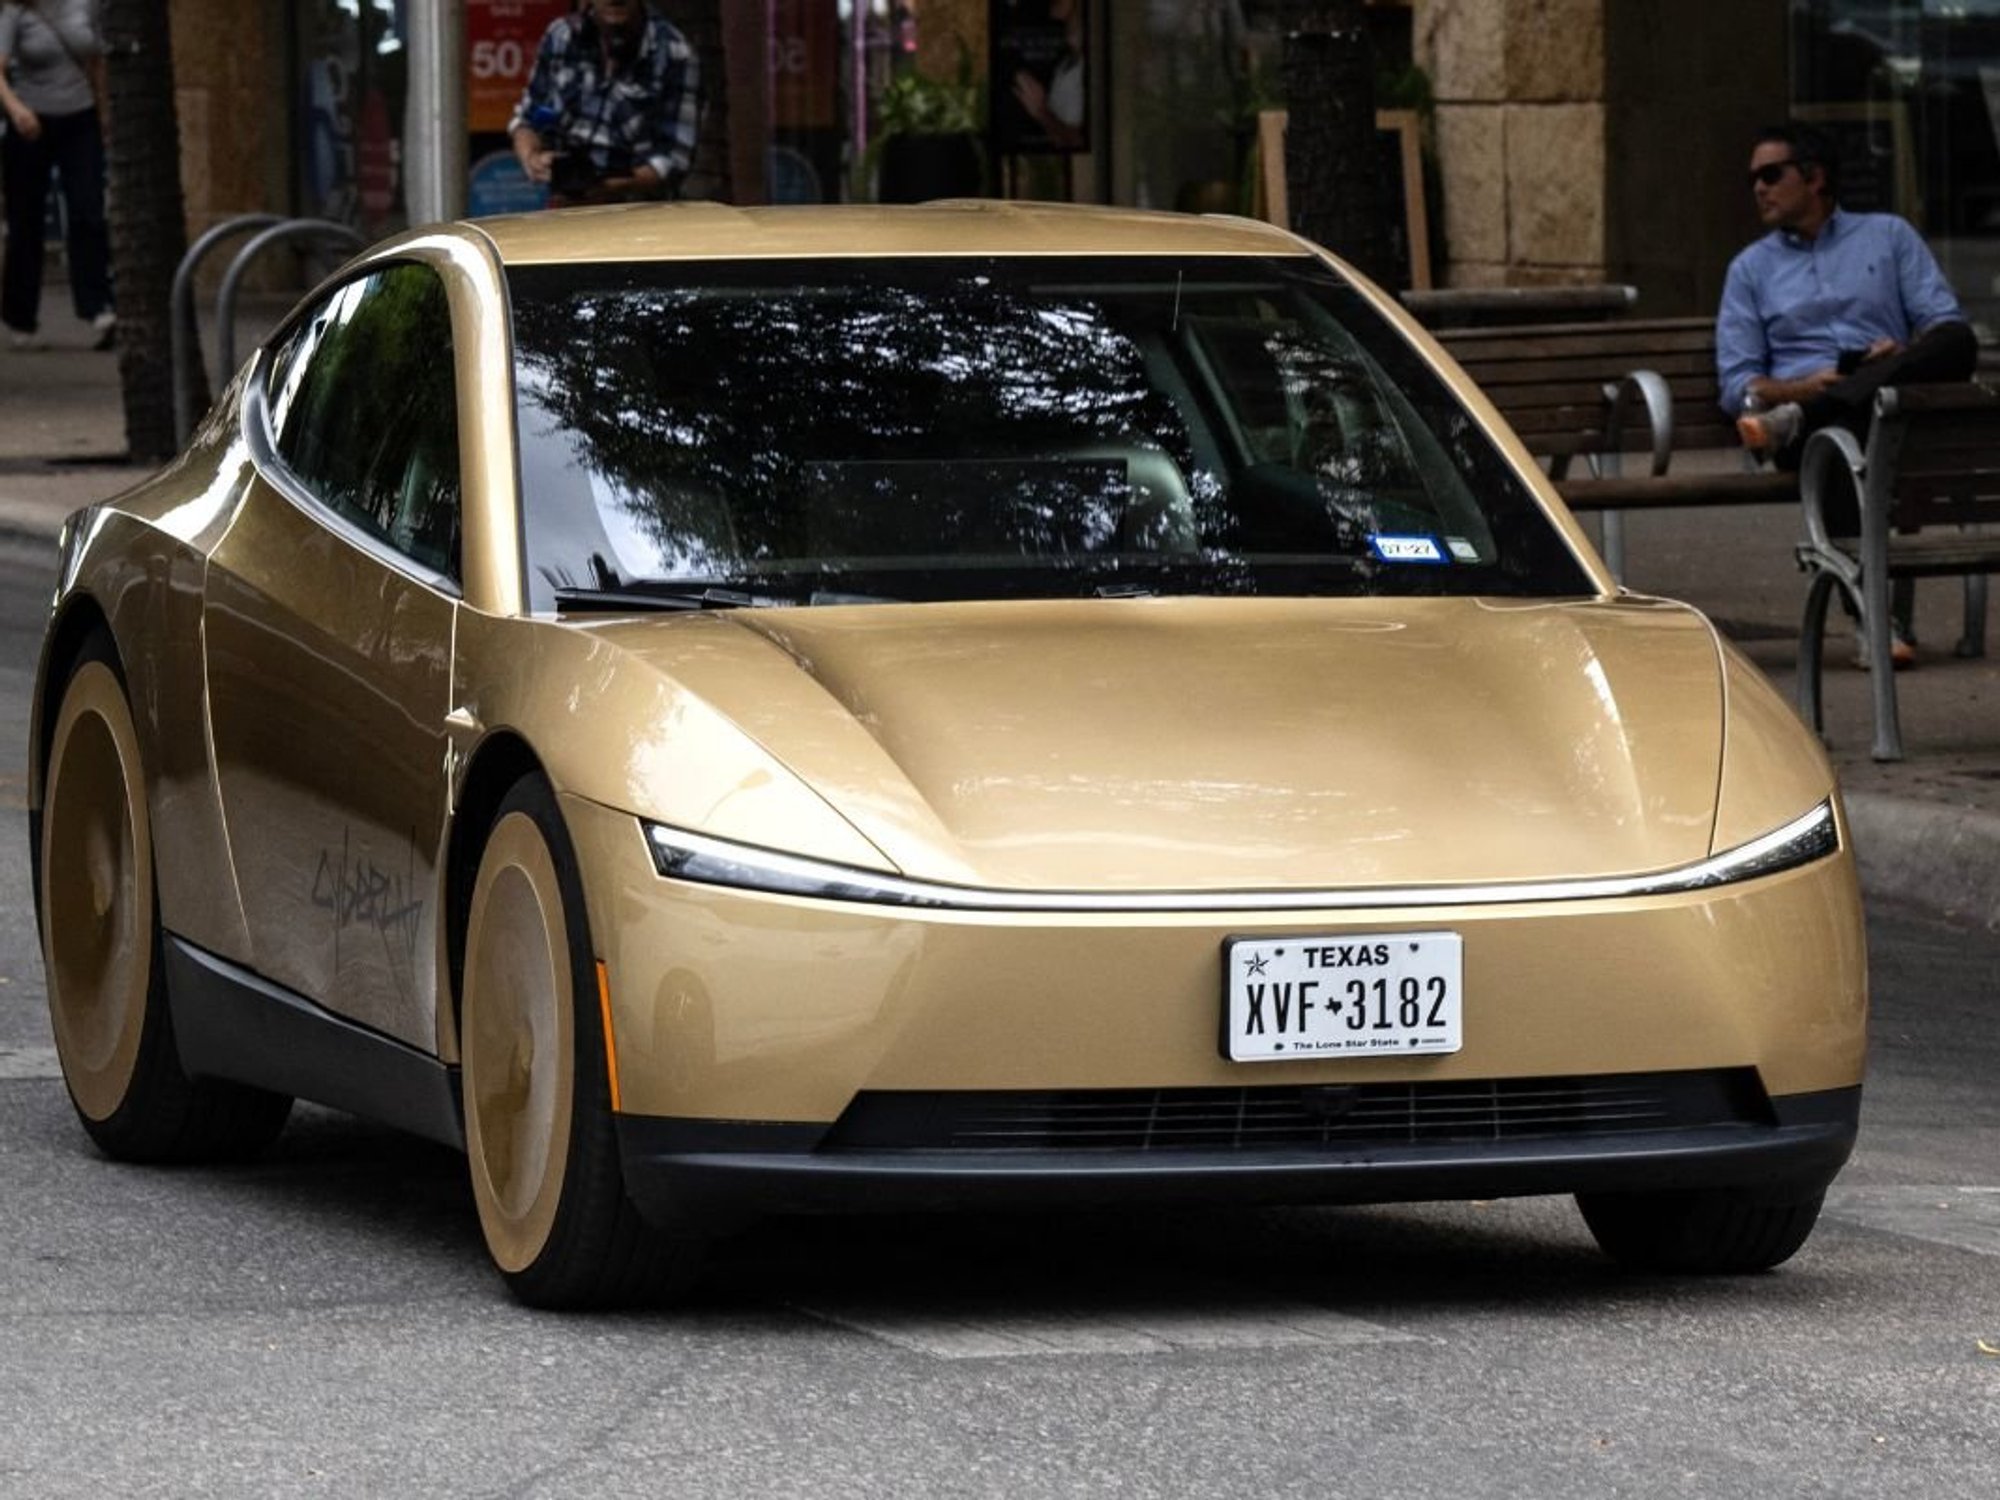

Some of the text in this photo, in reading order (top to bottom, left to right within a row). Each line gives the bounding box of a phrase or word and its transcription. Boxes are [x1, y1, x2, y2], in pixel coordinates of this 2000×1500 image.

[472, 40, 523, 79] 50
[1303, 944, 1390, 968] TEXAS
[1293, 1038, 1399, 1050] The Lone Star State
